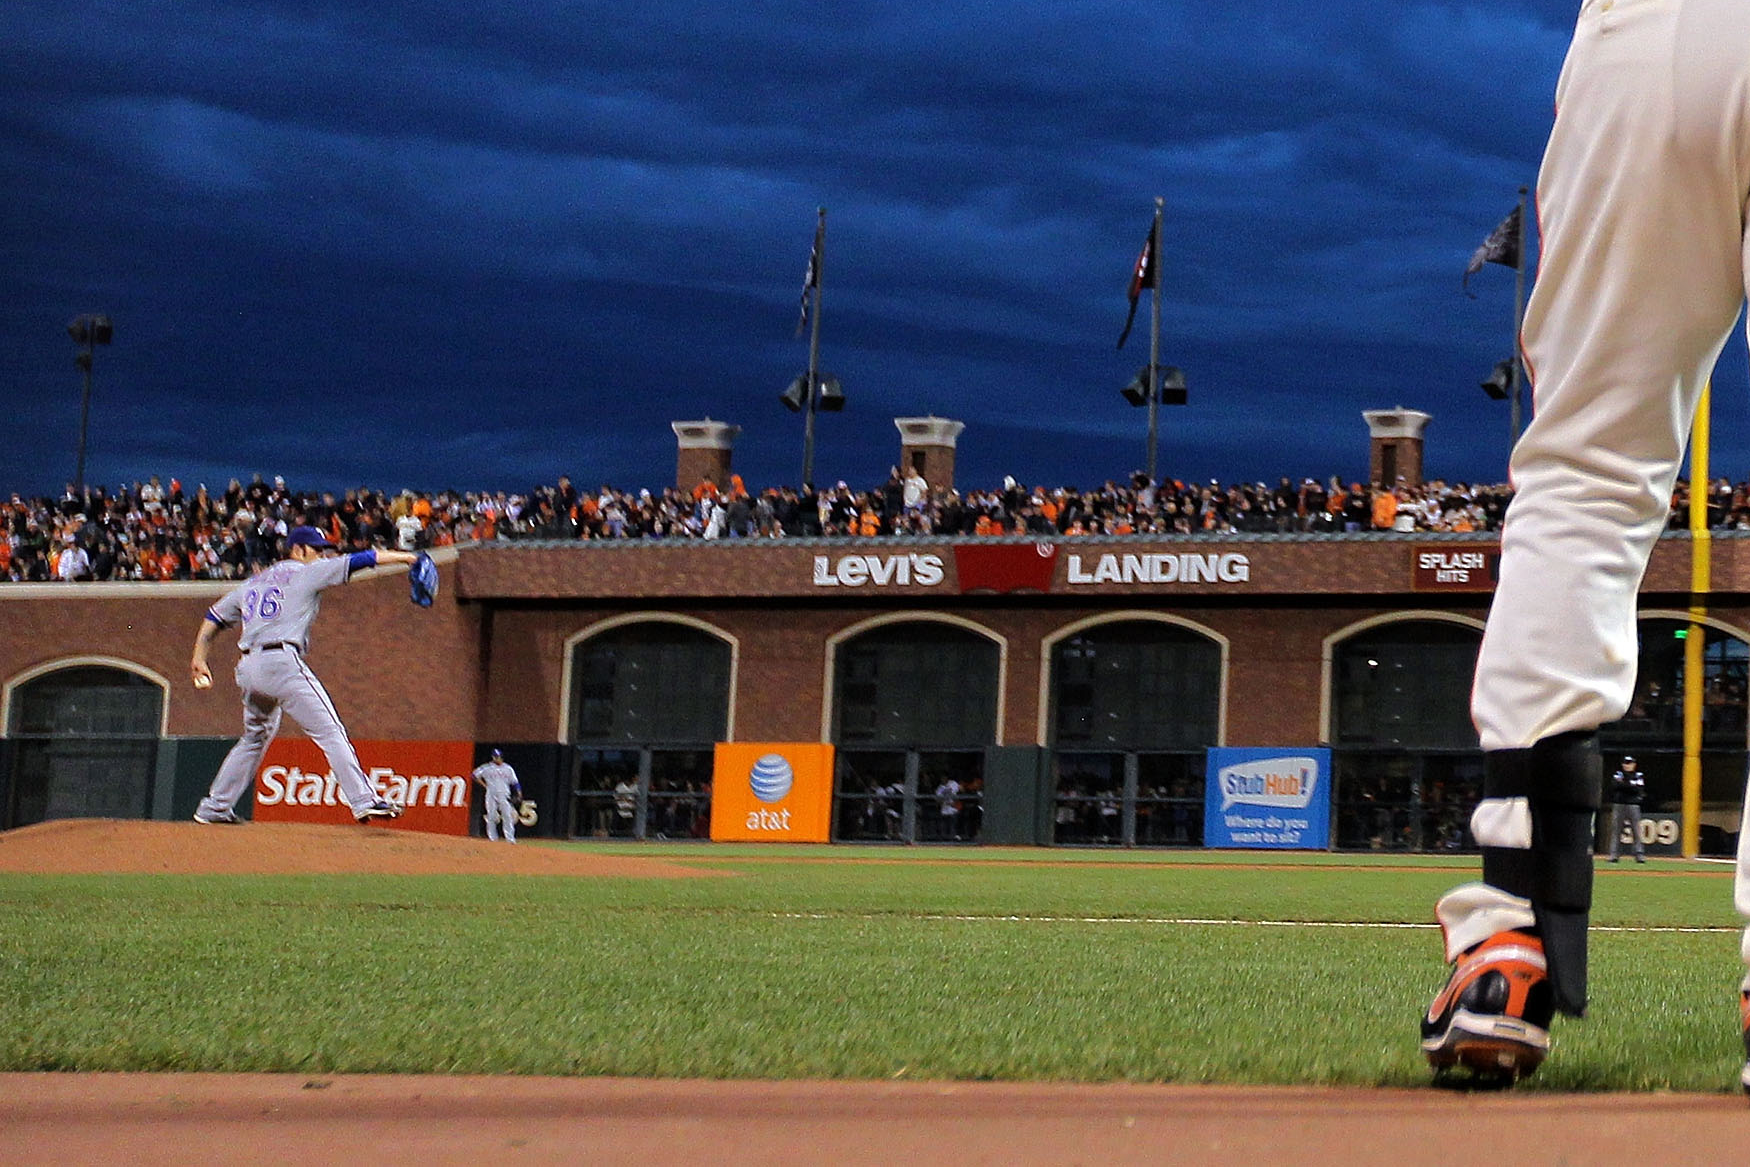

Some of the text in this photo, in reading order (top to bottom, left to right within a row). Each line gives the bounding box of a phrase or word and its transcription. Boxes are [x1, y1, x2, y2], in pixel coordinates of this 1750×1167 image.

[1067, 554, 1250, 584] LANDING
[1419, 552, 1485, 569] SPLASH
[1436, 569, 1469, 583] HITS
[1226, 767, 1310, 795] StubHub!
[745, 807, 791, 831] at&t
